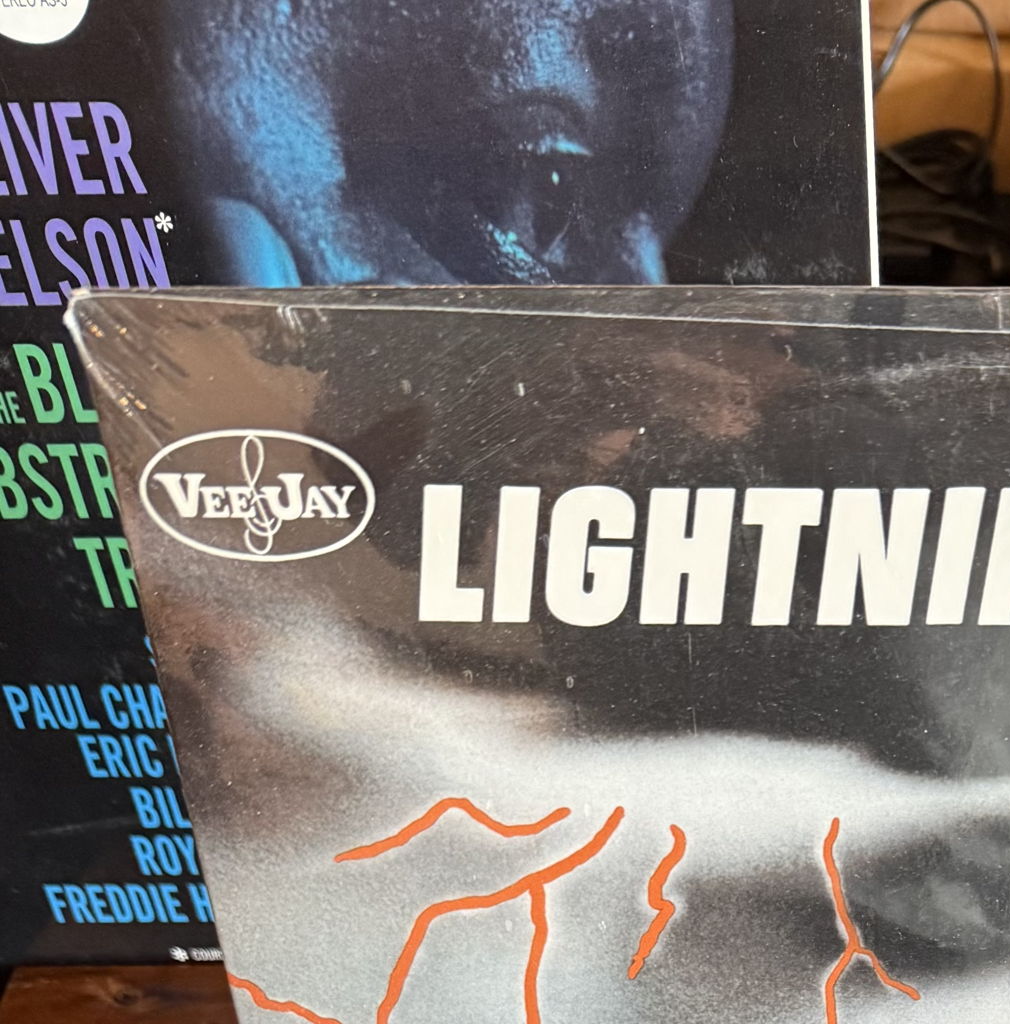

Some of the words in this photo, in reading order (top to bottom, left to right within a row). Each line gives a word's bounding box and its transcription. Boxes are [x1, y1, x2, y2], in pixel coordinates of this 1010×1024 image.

[0, 101, 148, 195] IVER
[2, 684, 101, 730] PAUL
[76, 734, 164, 778] ERIC
[42, 883, 189, 924] FREDDIE
